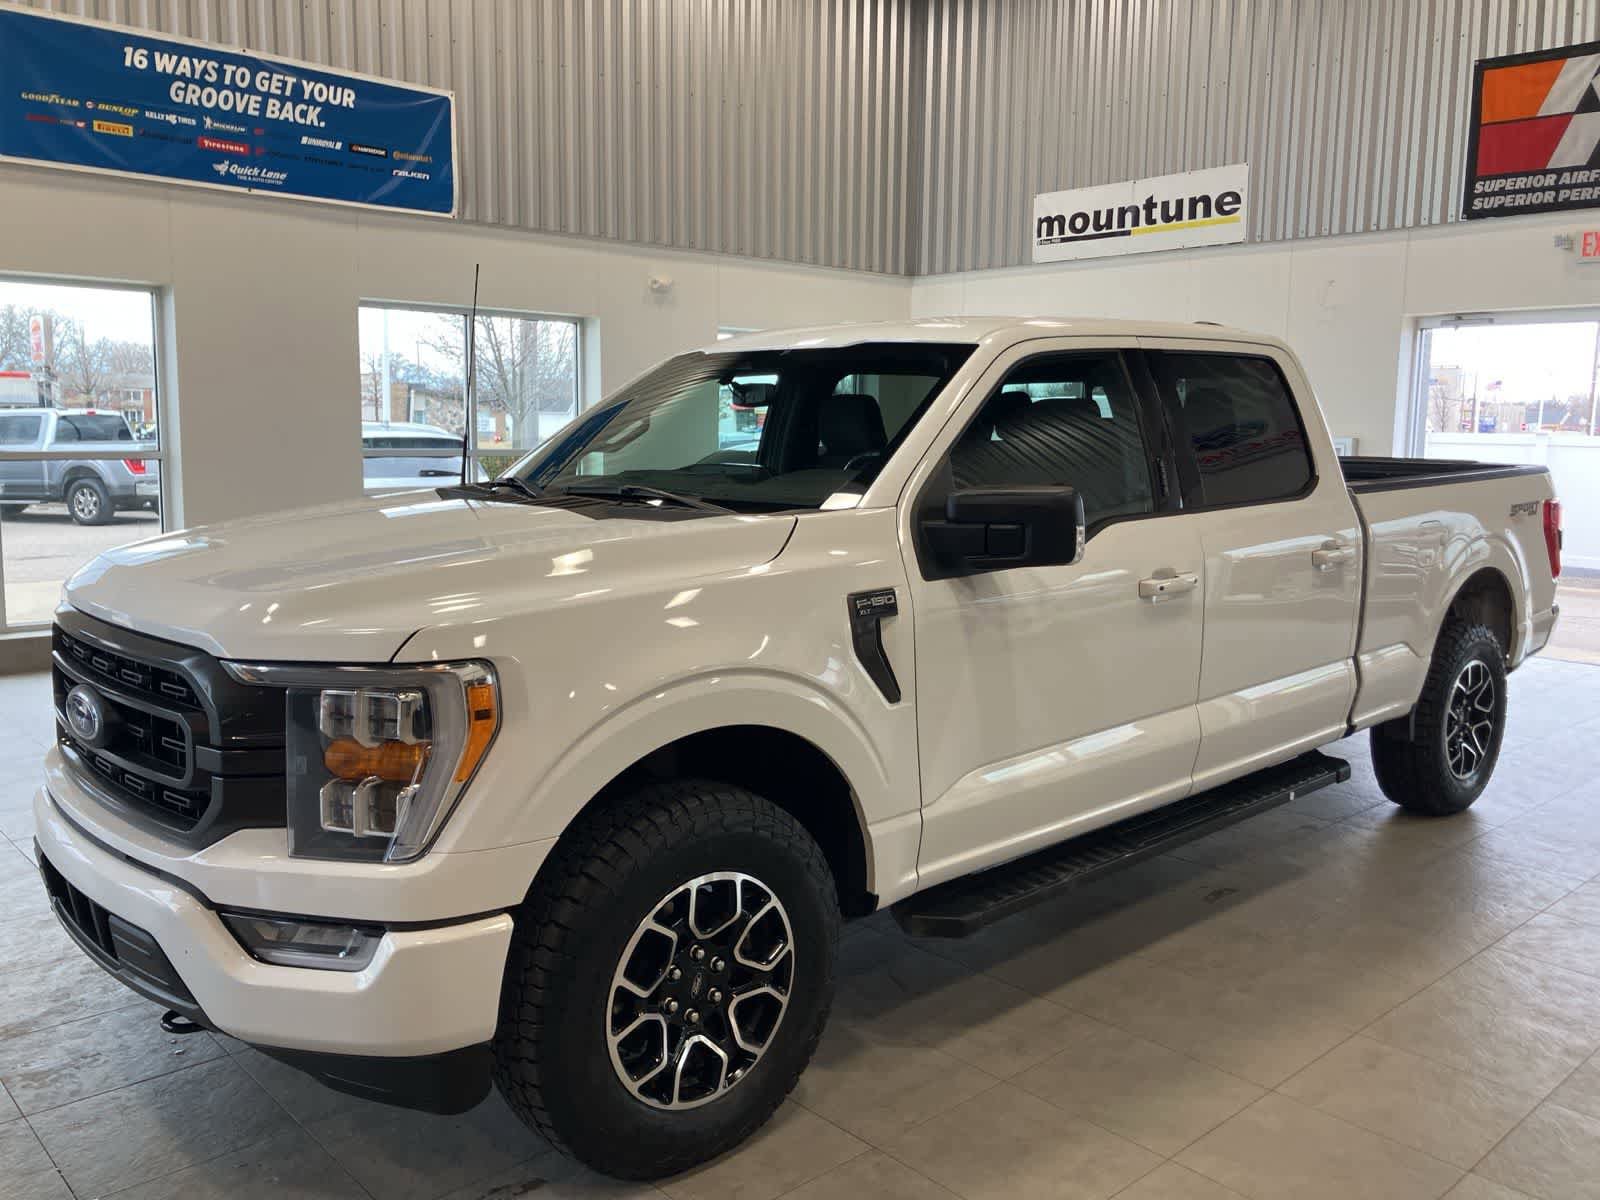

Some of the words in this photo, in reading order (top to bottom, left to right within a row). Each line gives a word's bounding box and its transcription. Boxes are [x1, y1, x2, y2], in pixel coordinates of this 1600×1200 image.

[123, 46, 148, 70] 16
[153, 51, 219, 83] WAYS
[223, 63, 251, 88] TO
[255, 71, 297, 97] GET
[302, 79, 356, 109] YOUR
[21, 92, 80, 107] GOODYEAR
[169, 80, 262, 117] GROOVE
[265, 97, 326, 128] BACK.
[98, 103, 139, 117] DUNLOP
[229, 164, 261, 177] Quick
[260, 168, 288, 180] Lane
[392, 169, 430, 181] FALKEN
[1474, 173, 1557, 194] SUPERIOR
[1472, 190, 1556, 210] SUPERIOR
[1036, 191, 1242, 238] mountune
